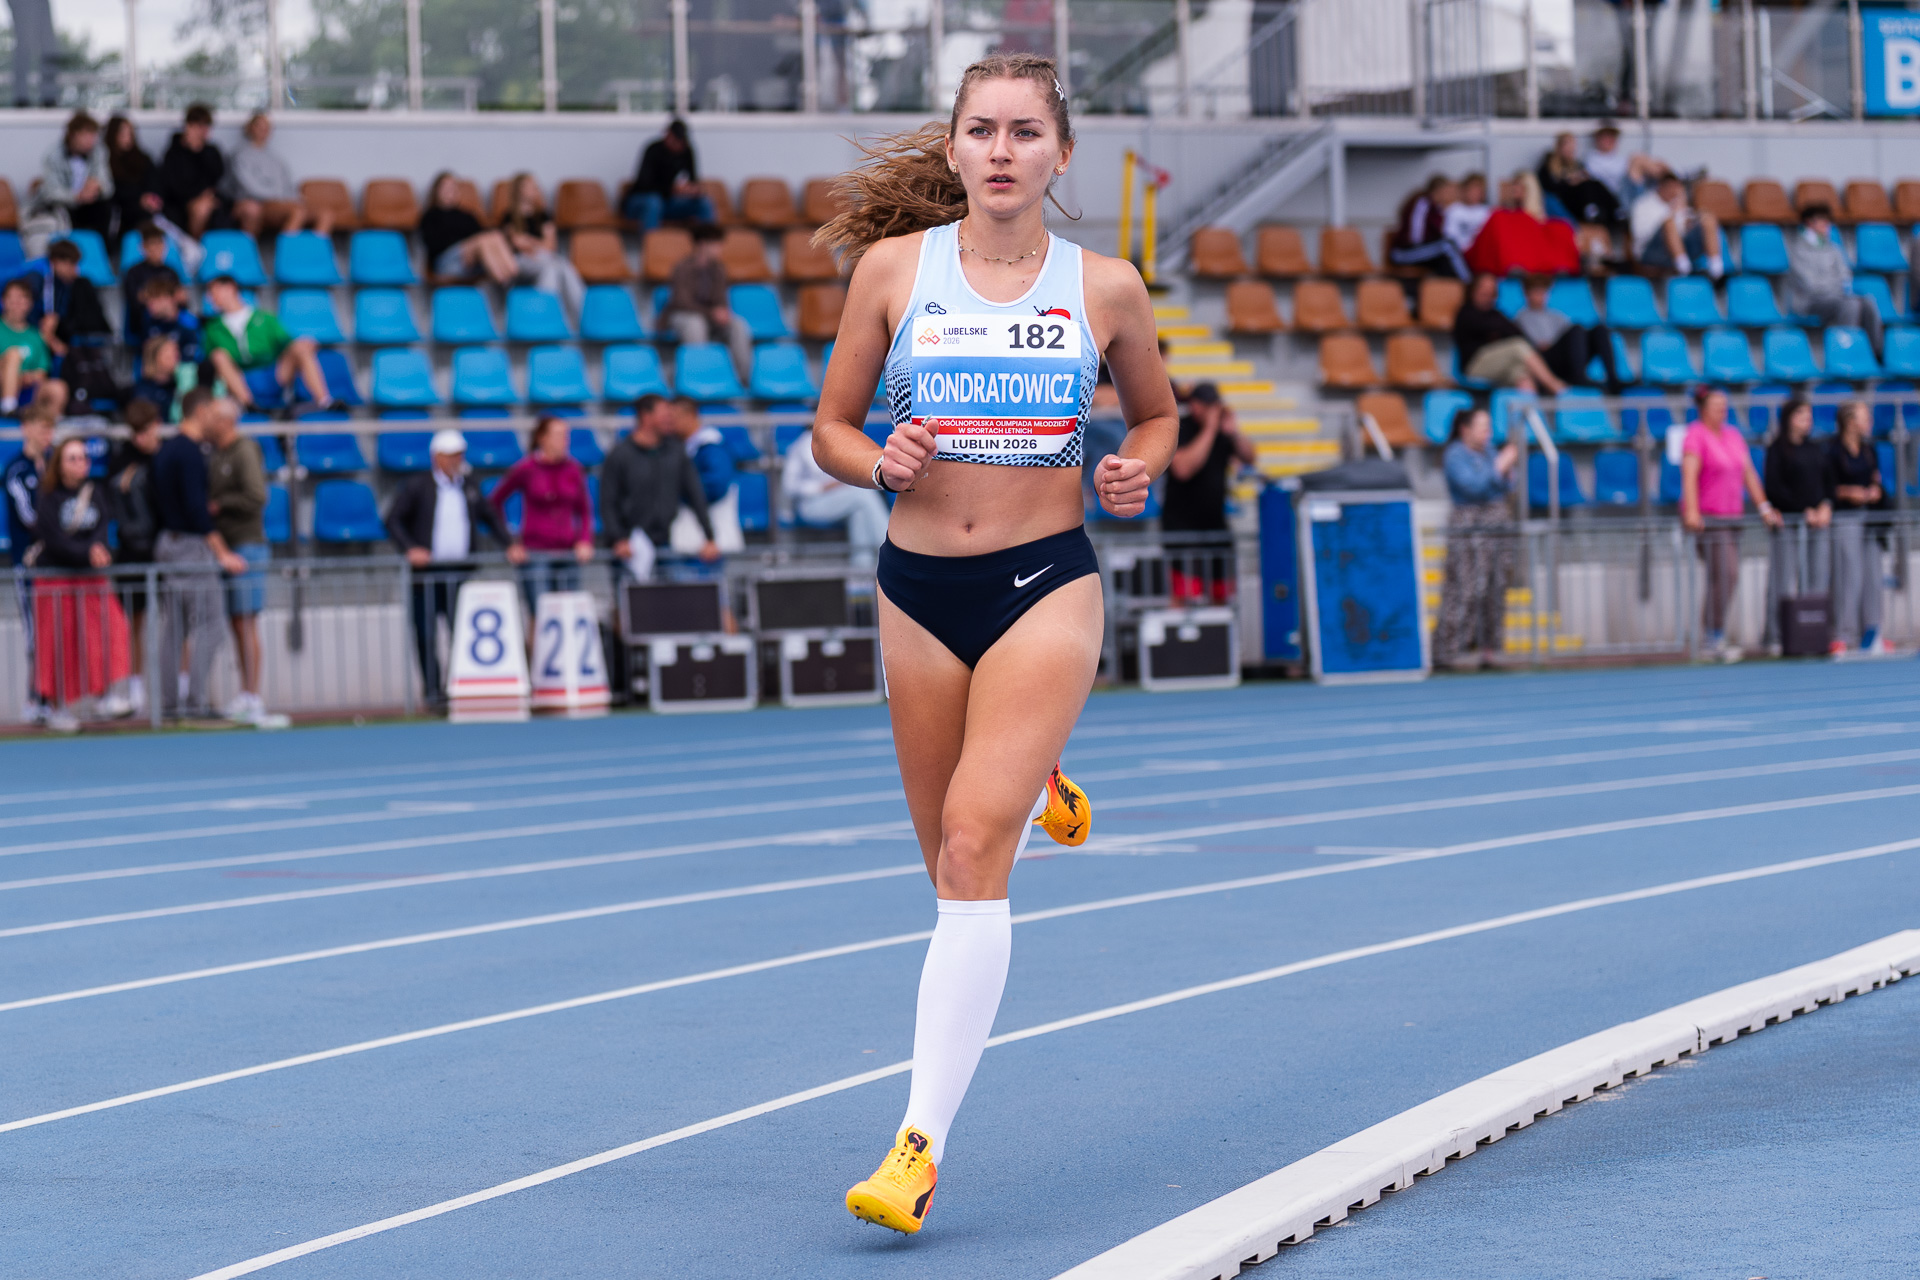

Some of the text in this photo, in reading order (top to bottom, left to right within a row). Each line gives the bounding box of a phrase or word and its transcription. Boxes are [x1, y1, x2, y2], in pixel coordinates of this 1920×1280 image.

[943, 327, 988, 336] LUBELSKIE
[1008, 323, 1065, 349] 182
[943, 337, 960, 345] 2026
[917, 372, 1075, 404] KONDRATOWICZ
[939, 418, 994, 427] OGÓLNOPOLSKA
[1033, 419, 1070, 427] MŁODZIEŻY
[952, 439, 1038, 449] LUBLIN 2026
[471, 608, 504, 666] 8
